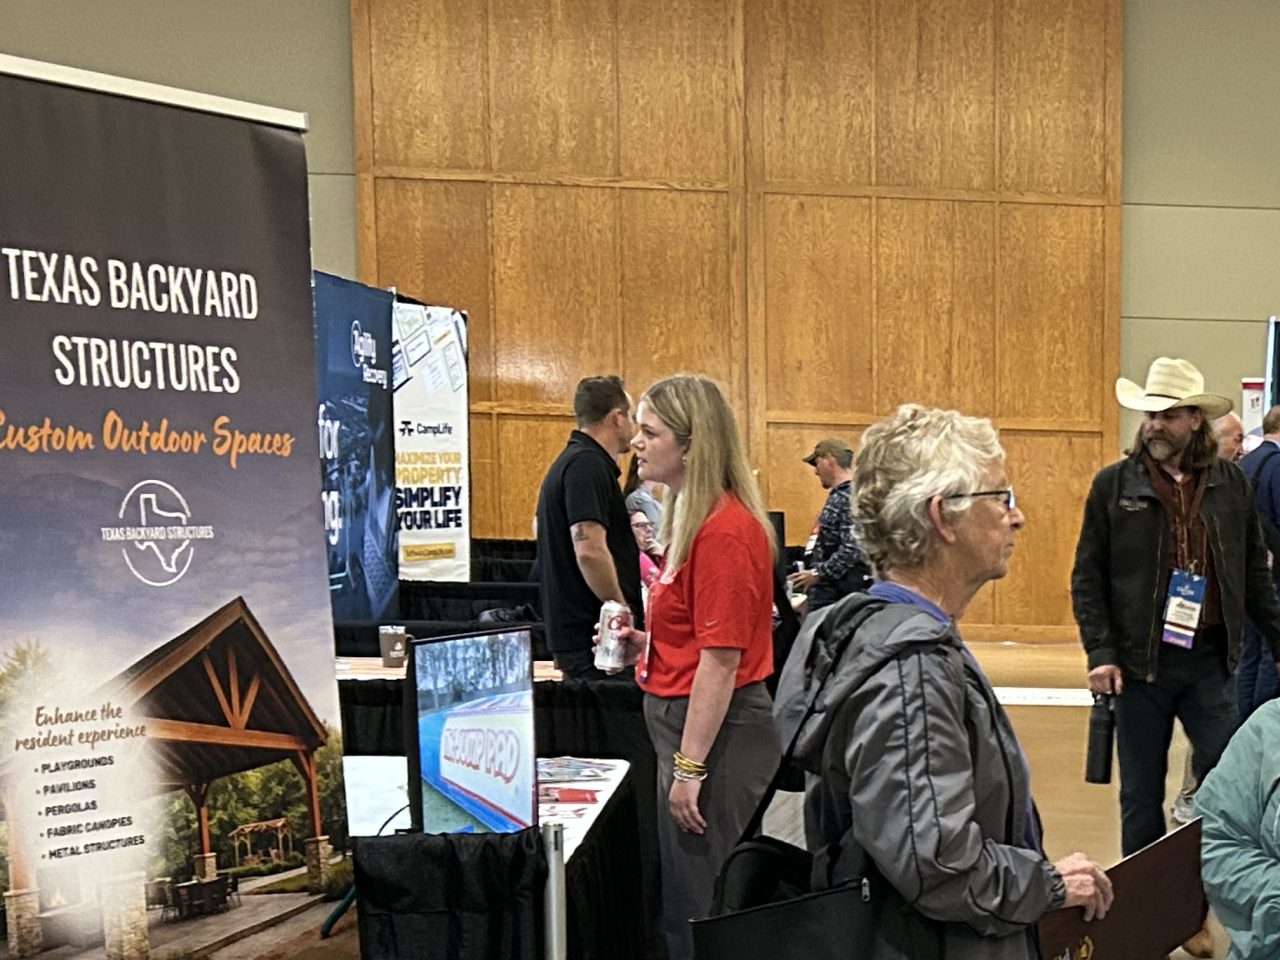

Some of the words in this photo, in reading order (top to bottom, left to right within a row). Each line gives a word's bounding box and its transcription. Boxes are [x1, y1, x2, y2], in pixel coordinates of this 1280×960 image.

[2, 247, 101, 307] TEXAS
[107, 258, 259, 320] BACKYARD
[52, 335, 241, 394] STRUCTURES
[0, 409, 94, 453] ustom
[103, 409, 207, 455] Outdoor
[212, 414, 295, 469] Spaces
[416, 423, 453, 438] CampLife
[396, 486, 463, 509] SIMPLIFY
[434, 508, 463, 528] LIFE
[101, 525, 126, 541] TEXAS
[126, 525, 166, 541] BACKYARD
[167, 525, 214, 540] STRUCTURES
[35, 705, 98, 727] Enhance
[100, 702, 123, 721] the
[15, 730, 75, 752] resident
[78, 722, 147, 750] experience
[41, 754, 114, 774] PLAYGROUNDS
[43, 779, 96, 796] PAVILIONS
[45, 800, 98, 817] PERGOLAS
[47, 822, 84, 839] FABRIC
[85, 816, 133, 834] CANOPIES
[49, 843, 82, 860] METAL
[83, 834, 145, 855] STRUCTURES
